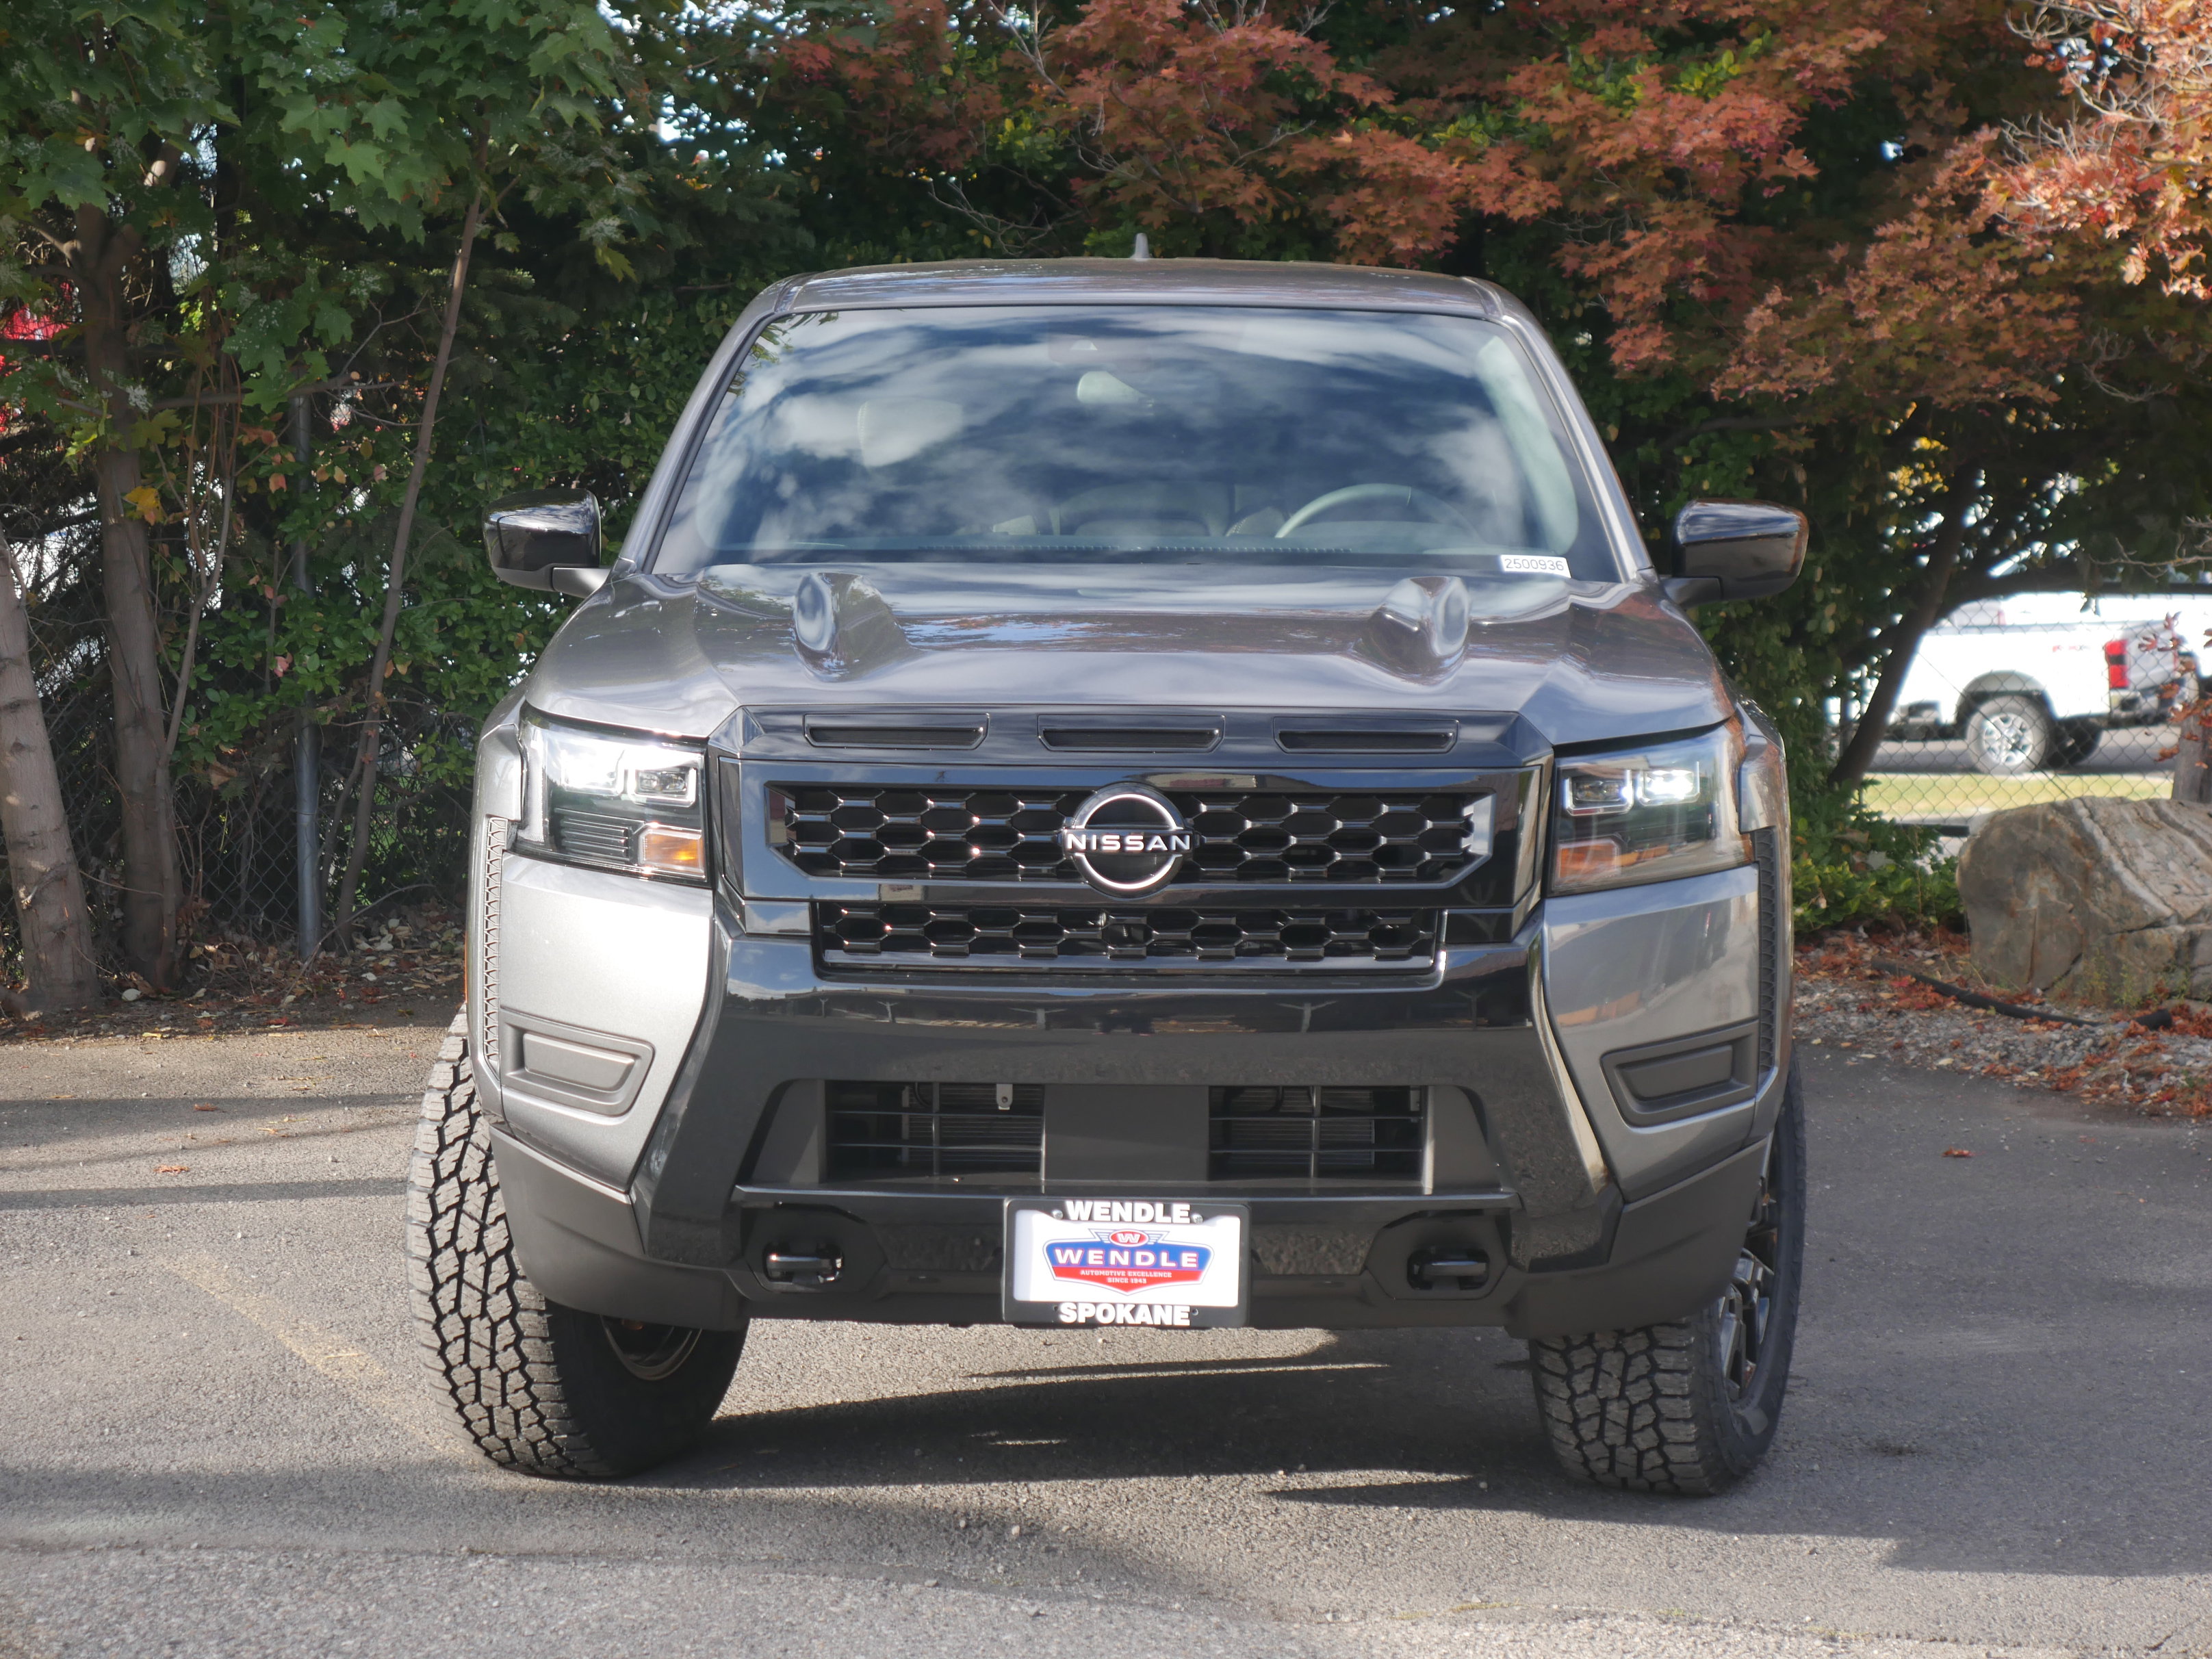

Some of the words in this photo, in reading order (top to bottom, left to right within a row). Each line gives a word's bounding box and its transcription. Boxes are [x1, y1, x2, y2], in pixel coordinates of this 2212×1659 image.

[1504, 558, 1565, 571] 2500936
[1066, 833, 1190, 851] NISSAN
[1066, 1200, 1190, 1223] WENDLE
[1055, 1248, 1198, 1268] WENDLE
[1059, 1302, 1190, 1326] SPOKANE
